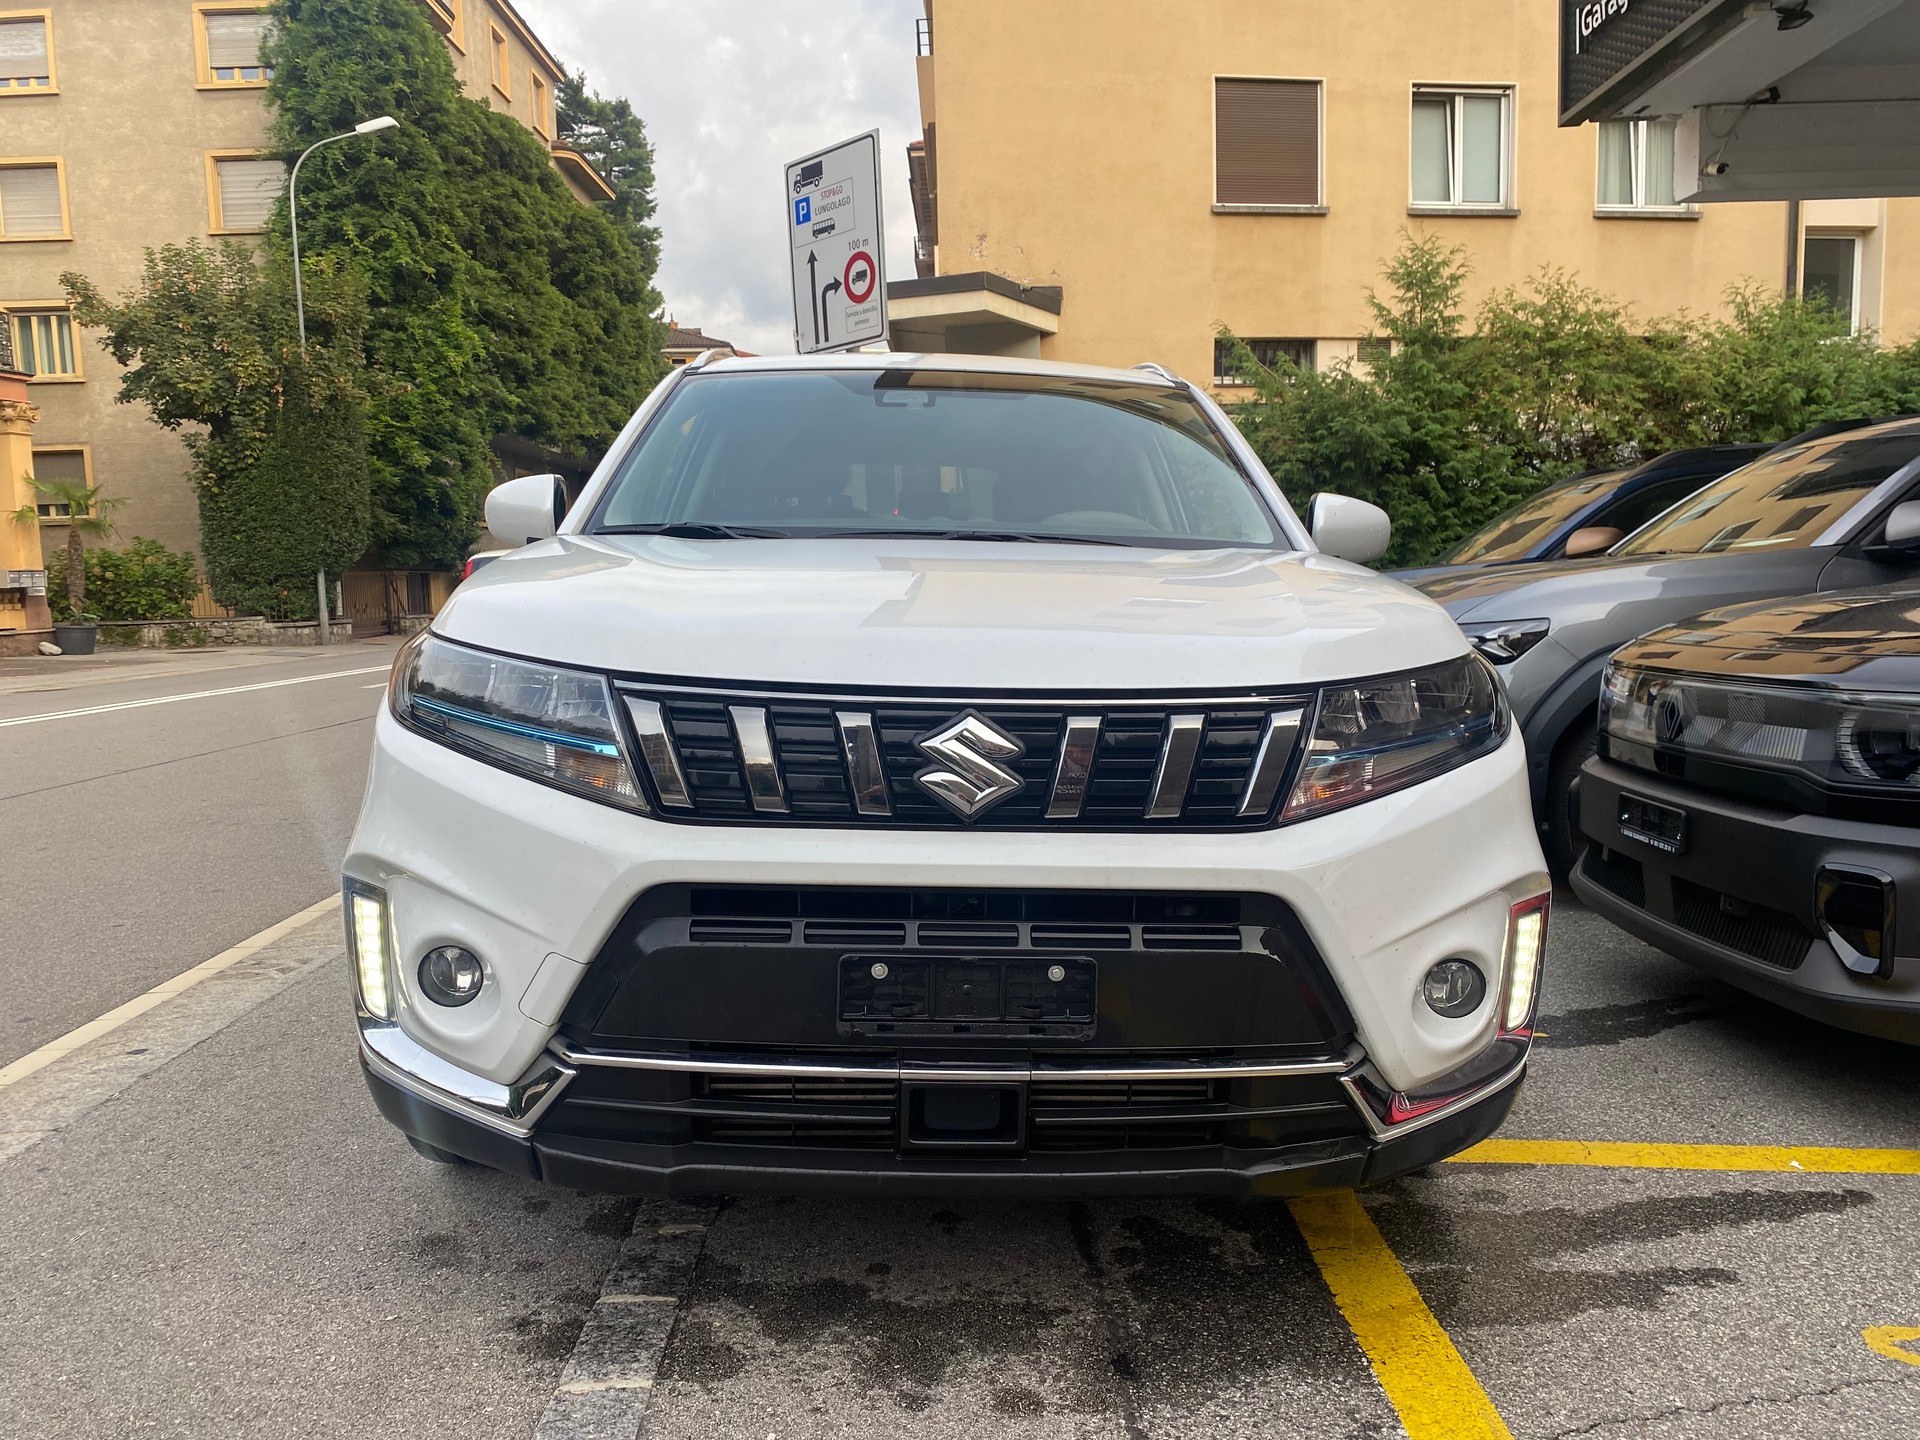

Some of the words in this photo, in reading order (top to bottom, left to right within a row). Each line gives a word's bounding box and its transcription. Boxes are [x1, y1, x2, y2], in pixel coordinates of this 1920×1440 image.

[820, 185, 843, 200] STOP&GO
[799, 202, 807, 221] P
[814, 196, 851, 215] LUNGOLAGO
[848, 238, 861, 251] 100
[862, 238, 869, 247] m
